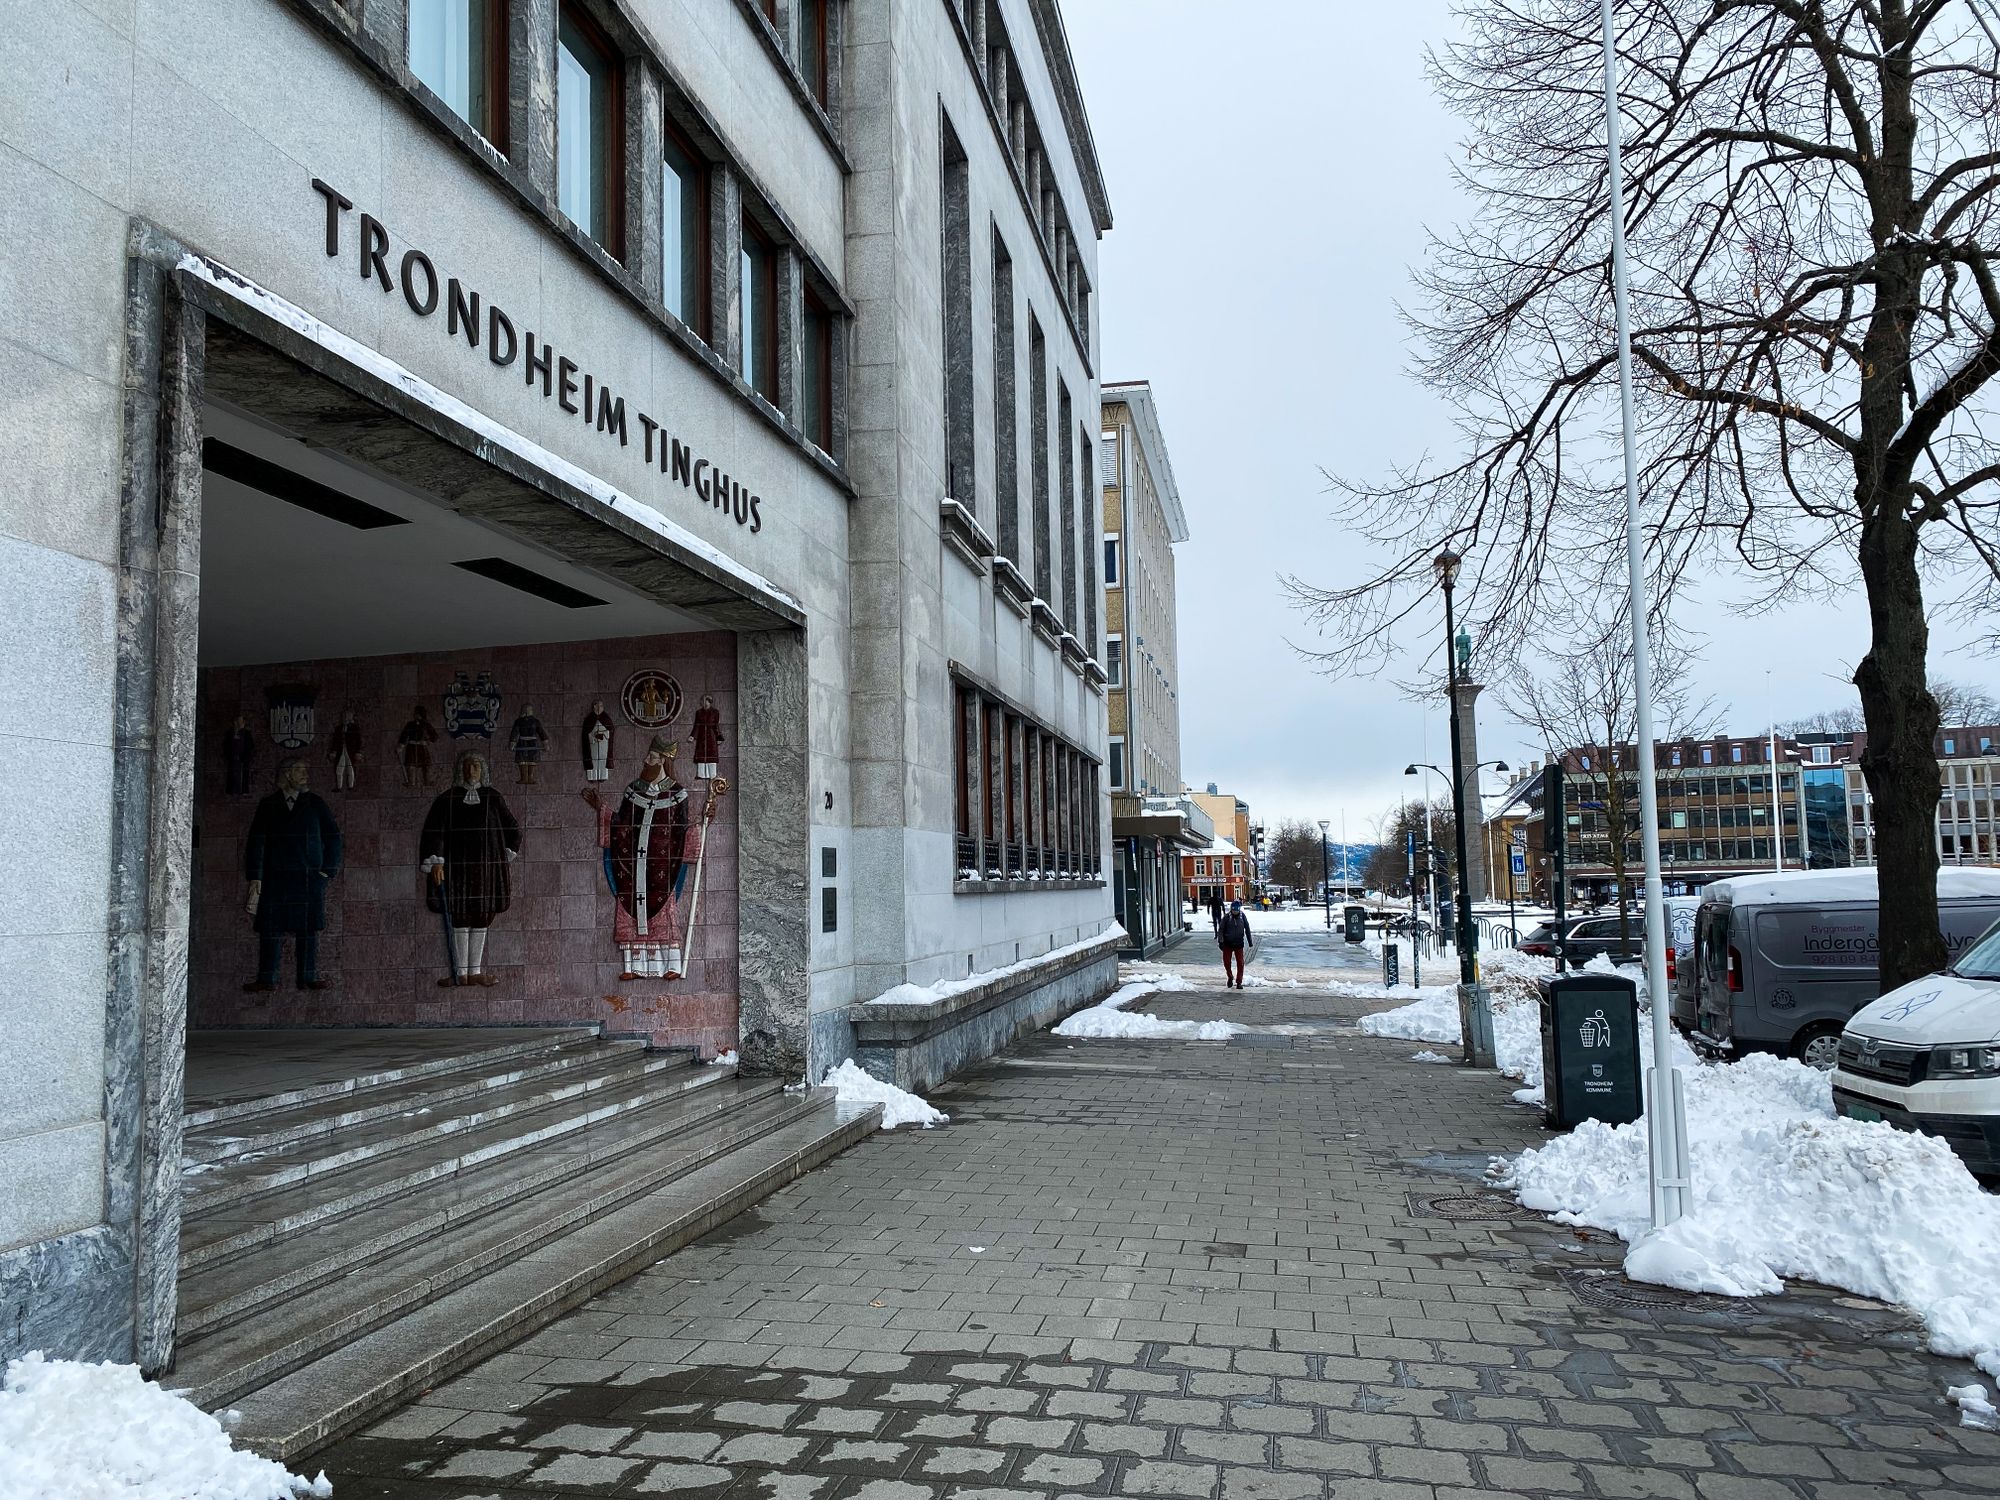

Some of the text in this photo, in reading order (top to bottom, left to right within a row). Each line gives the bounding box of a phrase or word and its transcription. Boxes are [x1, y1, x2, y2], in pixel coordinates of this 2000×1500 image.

[311, 178, 762, 533] TRONDHEIM TINGHUS
[825, 791, 833, 811] 20
[1811, 924, 1866, 934] Byggmester
[1803, 934, 1880, 953] Indergå
[1812, 954, 1836, 965] 928
[1840, 954, 1856, 965] 09
[1857, 1054, 1880, 1068] MAN
